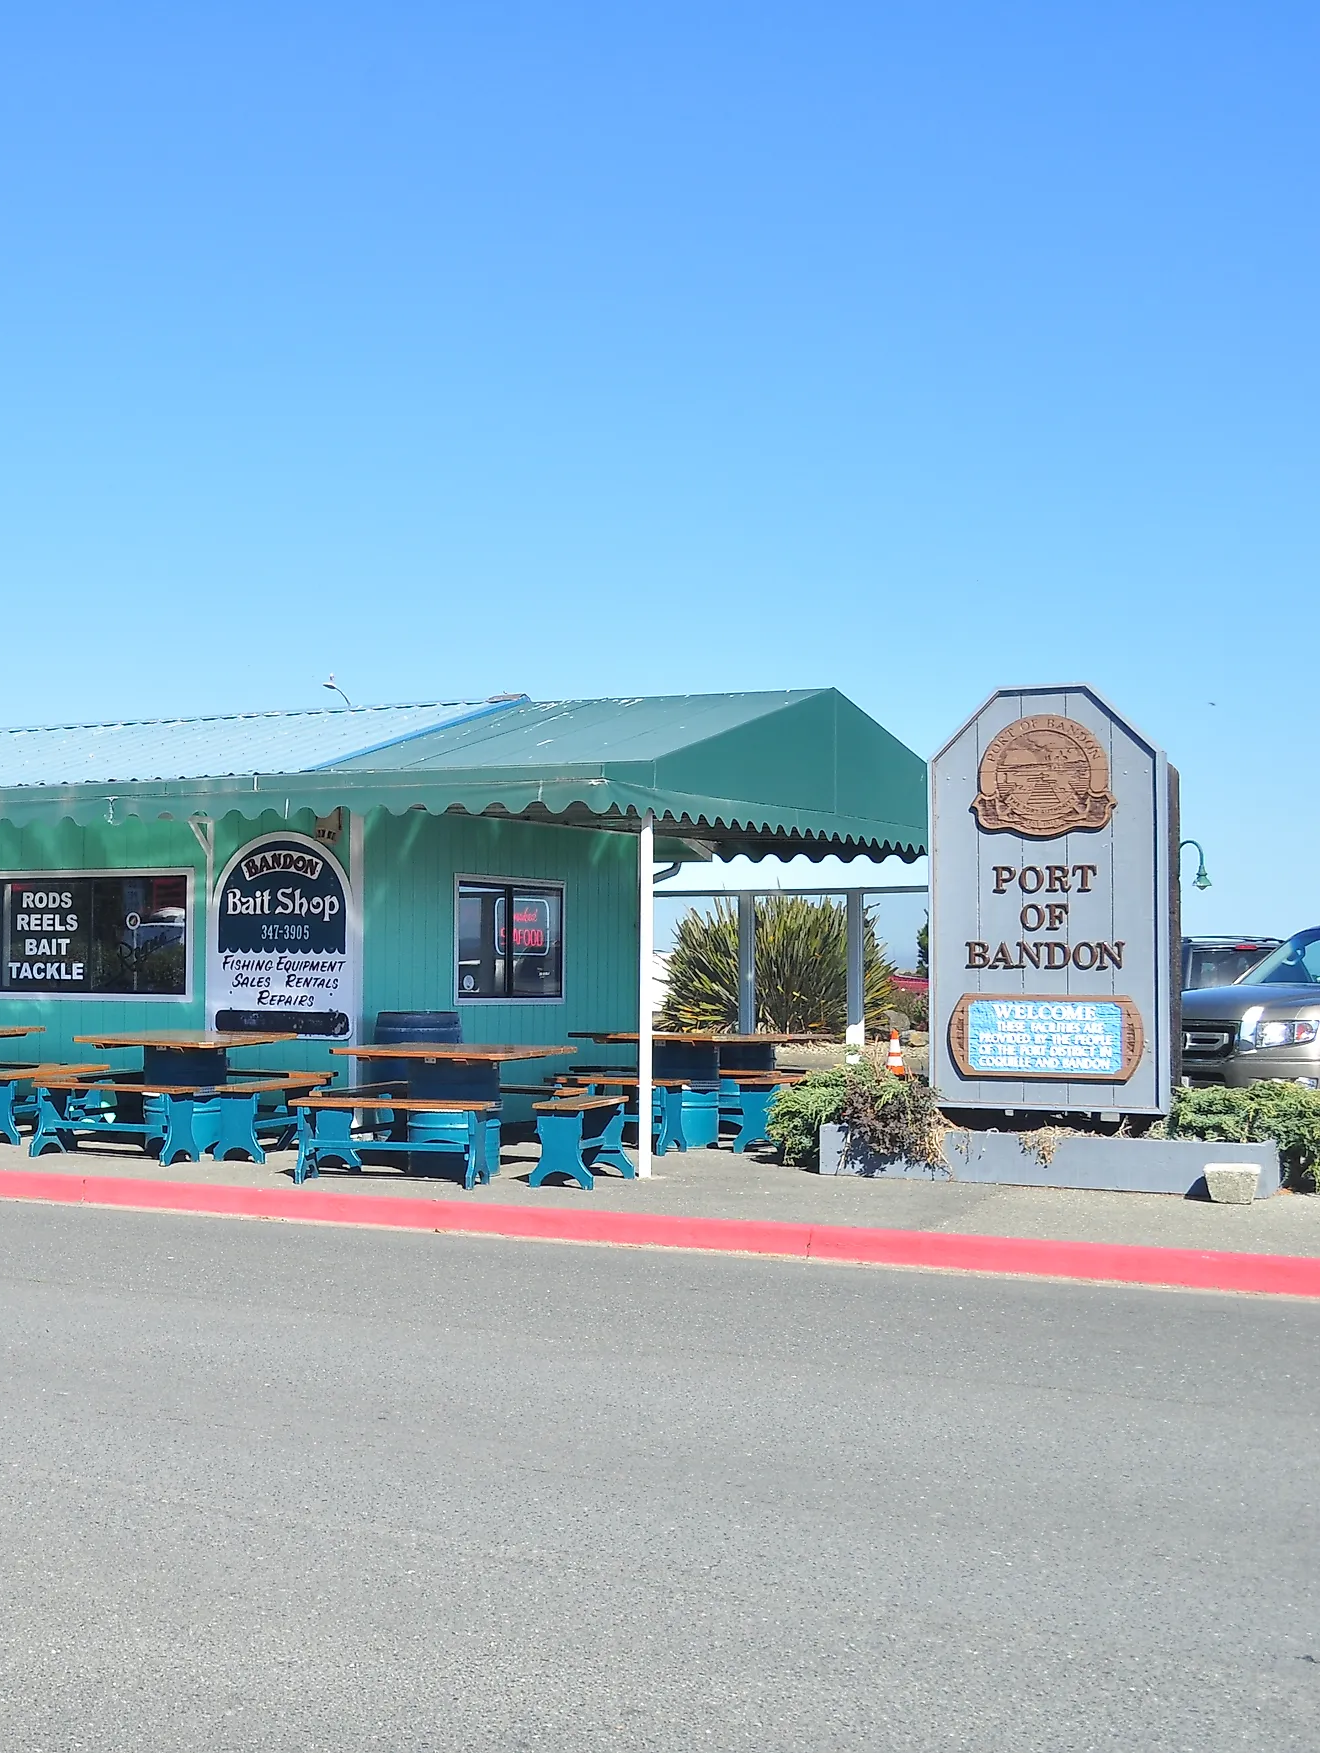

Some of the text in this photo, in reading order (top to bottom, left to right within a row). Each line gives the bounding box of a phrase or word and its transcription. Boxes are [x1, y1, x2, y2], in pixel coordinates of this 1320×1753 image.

[986, 718, 1101, 763] PORT OF BANDON
[244, 853, 322, 877] BANDON
[992, 864, 1097, 894] PORT
[22, 892, 73, 909] RODS
[227, 887, 340, 921] Bait Shop
[16, 914, 79, 932] REELS
[1020, 903, 1069, 931] OF
[261, 924, 310, 940] 347-3905
[25, 938, 71, 956] BAIT
[965, 940, 1126, 970] BANDON
[8, 962, 84, 980] TACKLE
[222, 955, 346, 974] FISHING EQUIPMENT
[232, 973, 339, 990] SALES RENTALS
[257, 990, 315, 1007] REPAIRS
[993, 1004, 1097, 1021] WELCOME
[996, 1022, 1105, 1033] THESE FACILITIES ARE
[979, 1034, 1113, 1046] PROVIDED BY THE PEOPLE
[979, 1046, 1113, 1058] OF THE PORT DISTRICT IN
[979, 1057, 1110, 1069] COQUILLE AND BANDON
